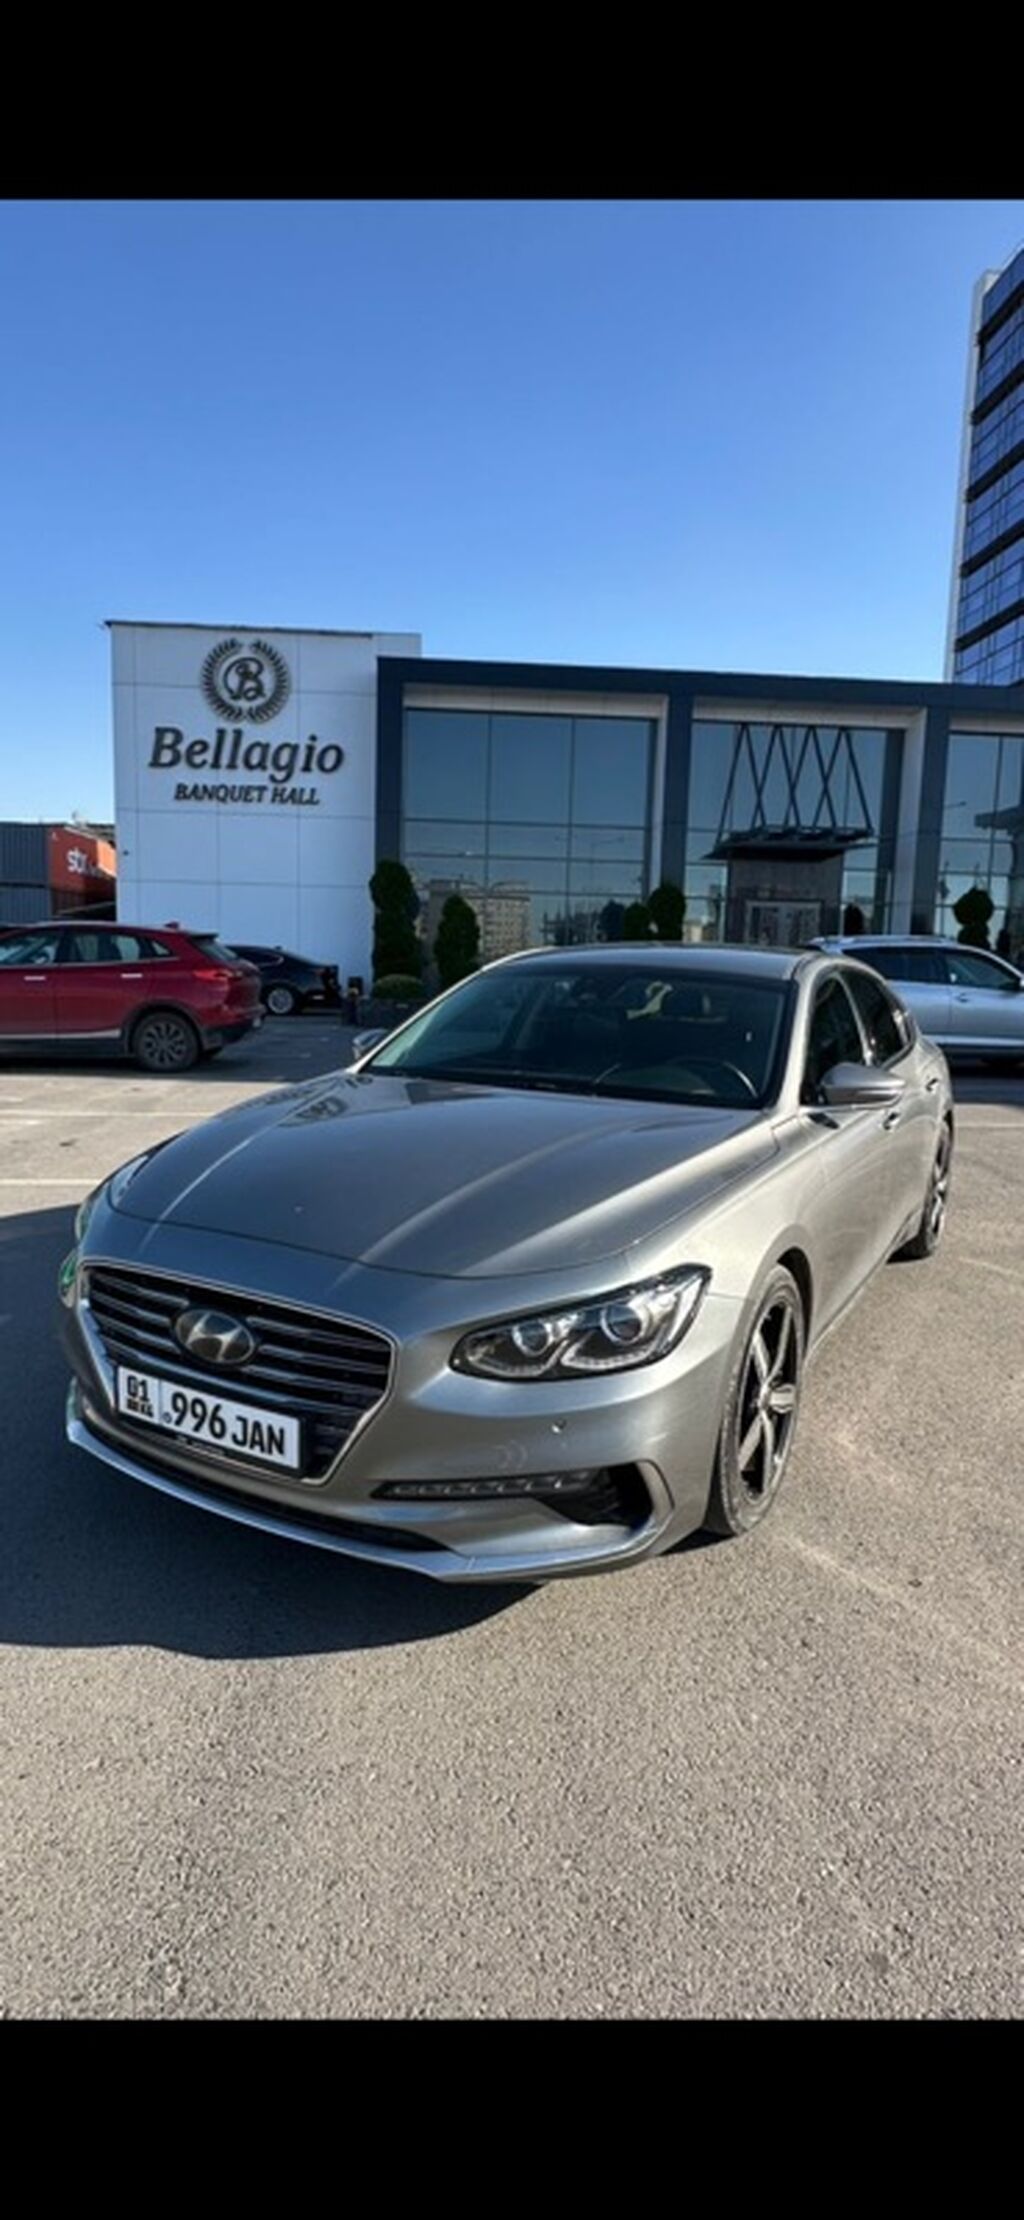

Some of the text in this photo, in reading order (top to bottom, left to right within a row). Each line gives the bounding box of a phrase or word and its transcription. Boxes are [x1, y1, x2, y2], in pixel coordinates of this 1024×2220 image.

[148, 726, 345, 784] Bellagio
[174, 783, 320, 806] BANQUET HALL
[127, 1375, 149, 1402] 01
[171, 1391, 226, 1439] 996
[231, 1415, 285, 1455] JAN
